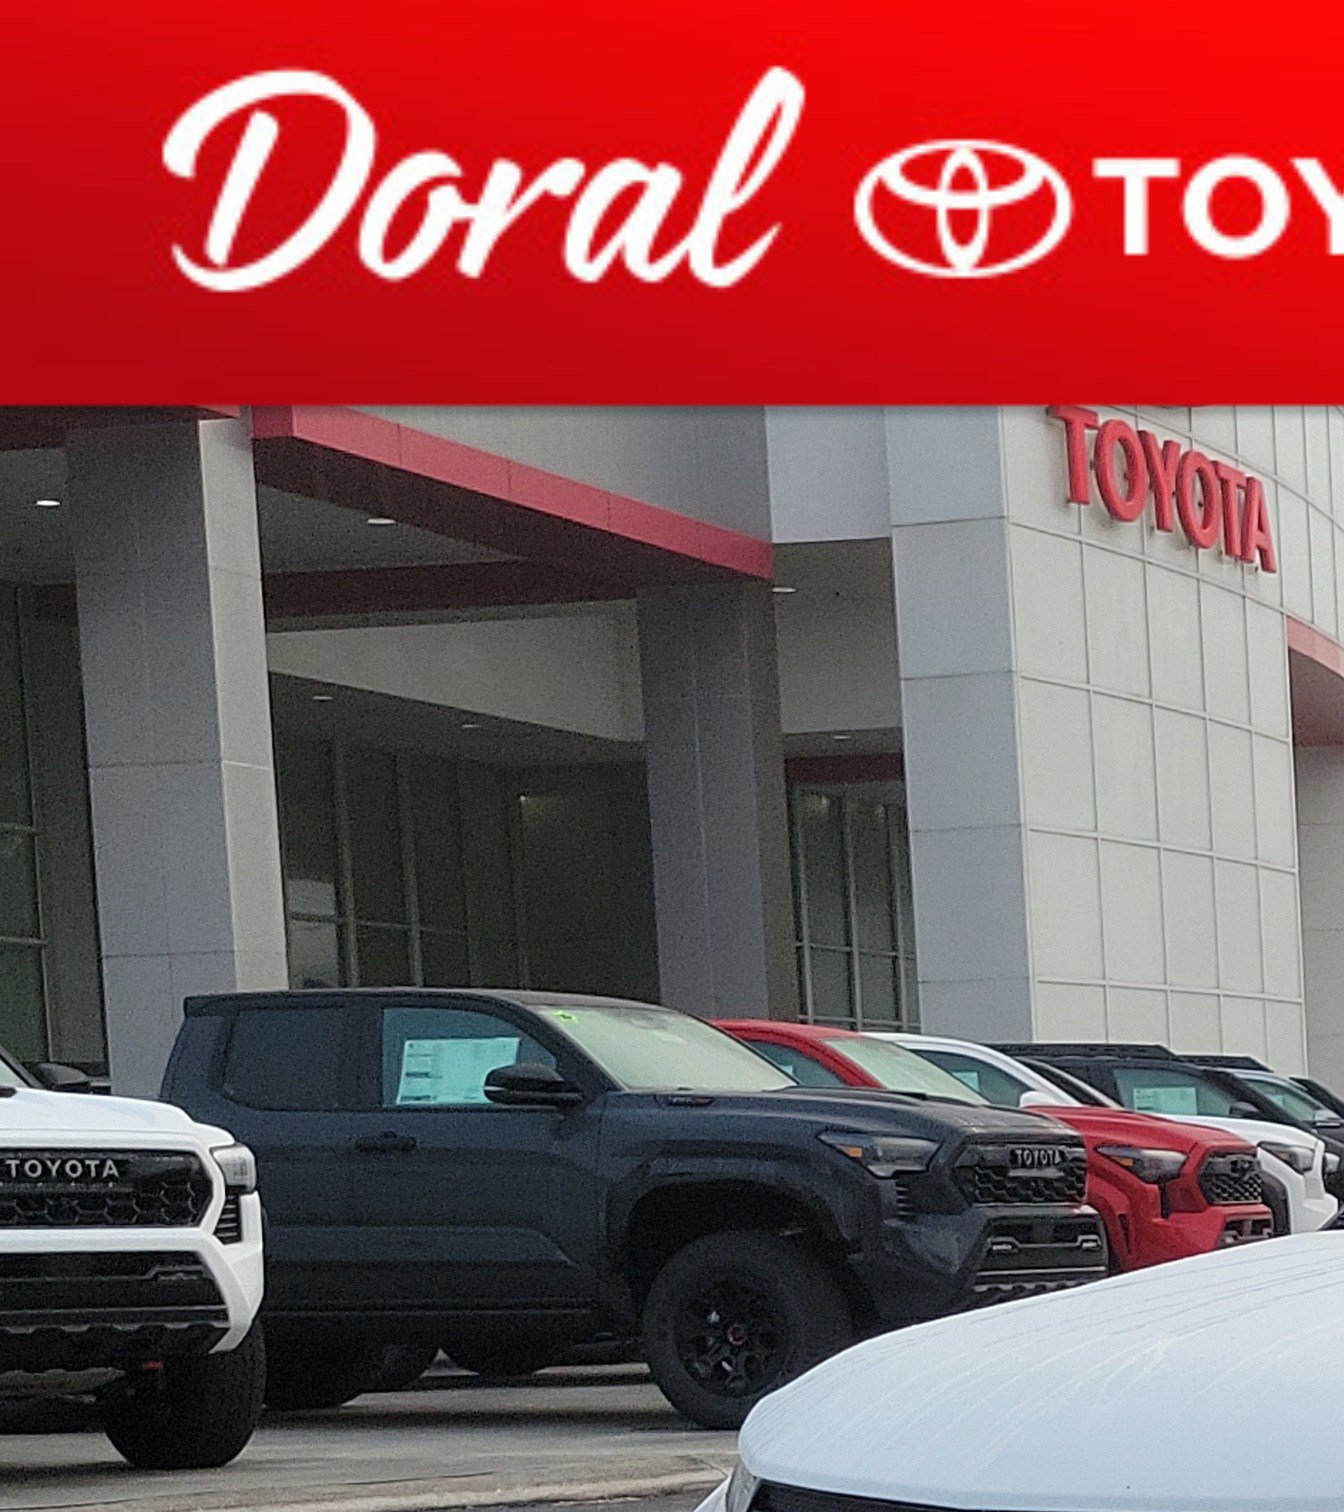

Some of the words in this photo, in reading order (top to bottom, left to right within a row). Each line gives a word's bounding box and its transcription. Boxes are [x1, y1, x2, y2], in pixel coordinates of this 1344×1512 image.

[1046, 404, 1277, 574] TOYOTA
[1014, 1148, 1062, 1168] TOYOTA
[4, 1159, 120, 1178] TOYOTA
